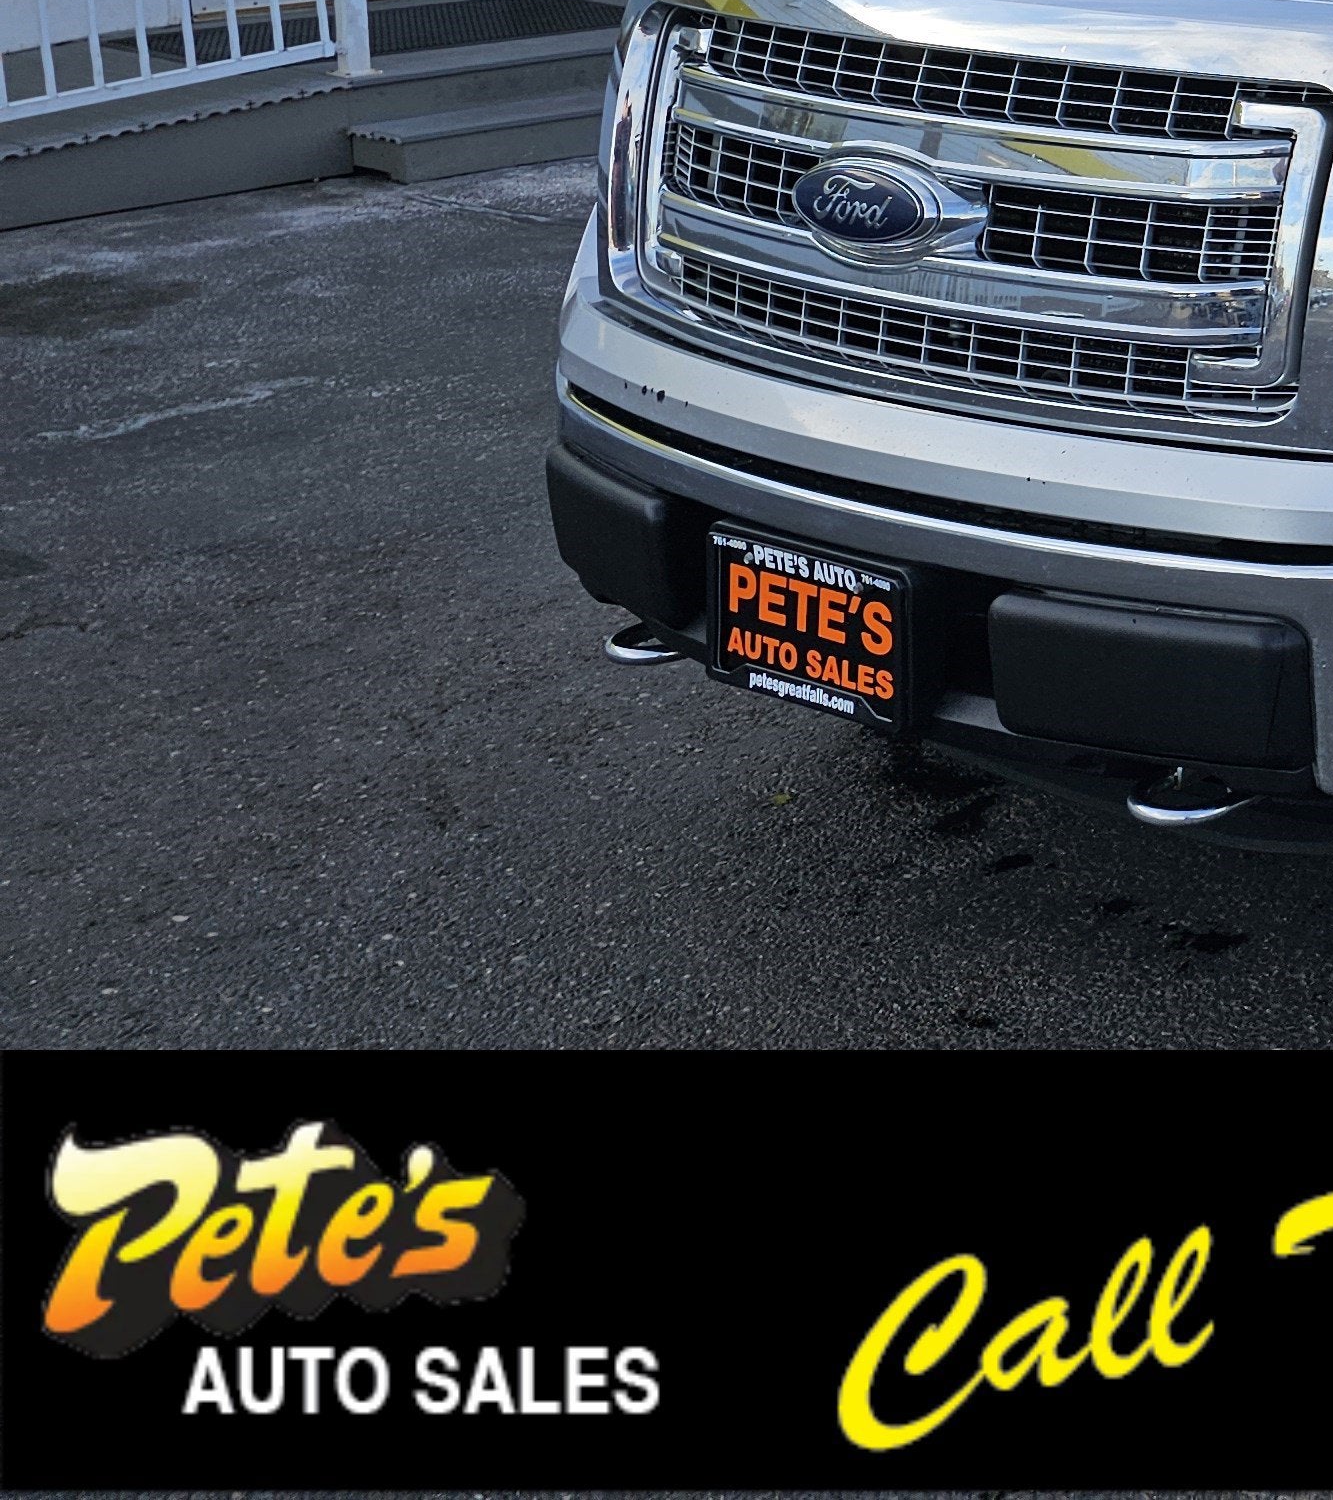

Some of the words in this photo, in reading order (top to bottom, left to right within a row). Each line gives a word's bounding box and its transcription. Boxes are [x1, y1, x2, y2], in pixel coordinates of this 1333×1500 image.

[812, 173, 894, 230] Ford
[752, 544, 810, 579] PETE'S
[813, 560, 856, 592] AUTO
[729, 562, 894, 656] PETE'S
[727, 626, 799, 672] AUTO
[805, 649, 895, 701] SALES
[749, 671, 856, 715] petesgreatfalls.com
